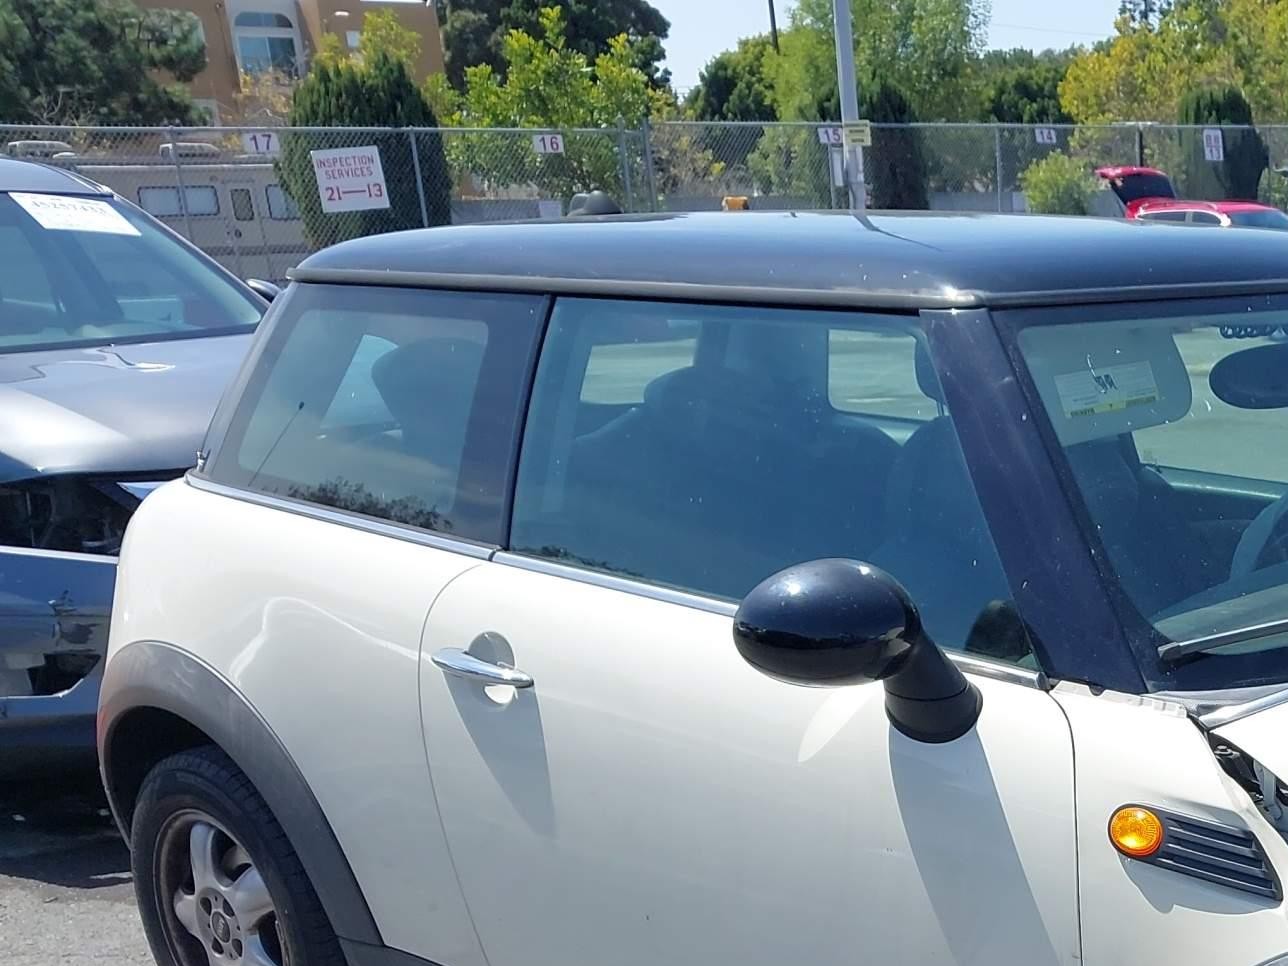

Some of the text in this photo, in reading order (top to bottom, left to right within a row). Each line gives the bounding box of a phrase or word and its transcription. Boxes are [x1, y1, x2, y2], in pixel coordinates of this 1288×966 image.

[825, 128, 841, 142] 15
[1040, 130, 1053, 141] 14
[251, 134, 272, 151] 17
[540, 136, 559, 151] 16
[316, 154, 375, 169] INSPECTION
[325, 166, 374, 180] SERVICES
